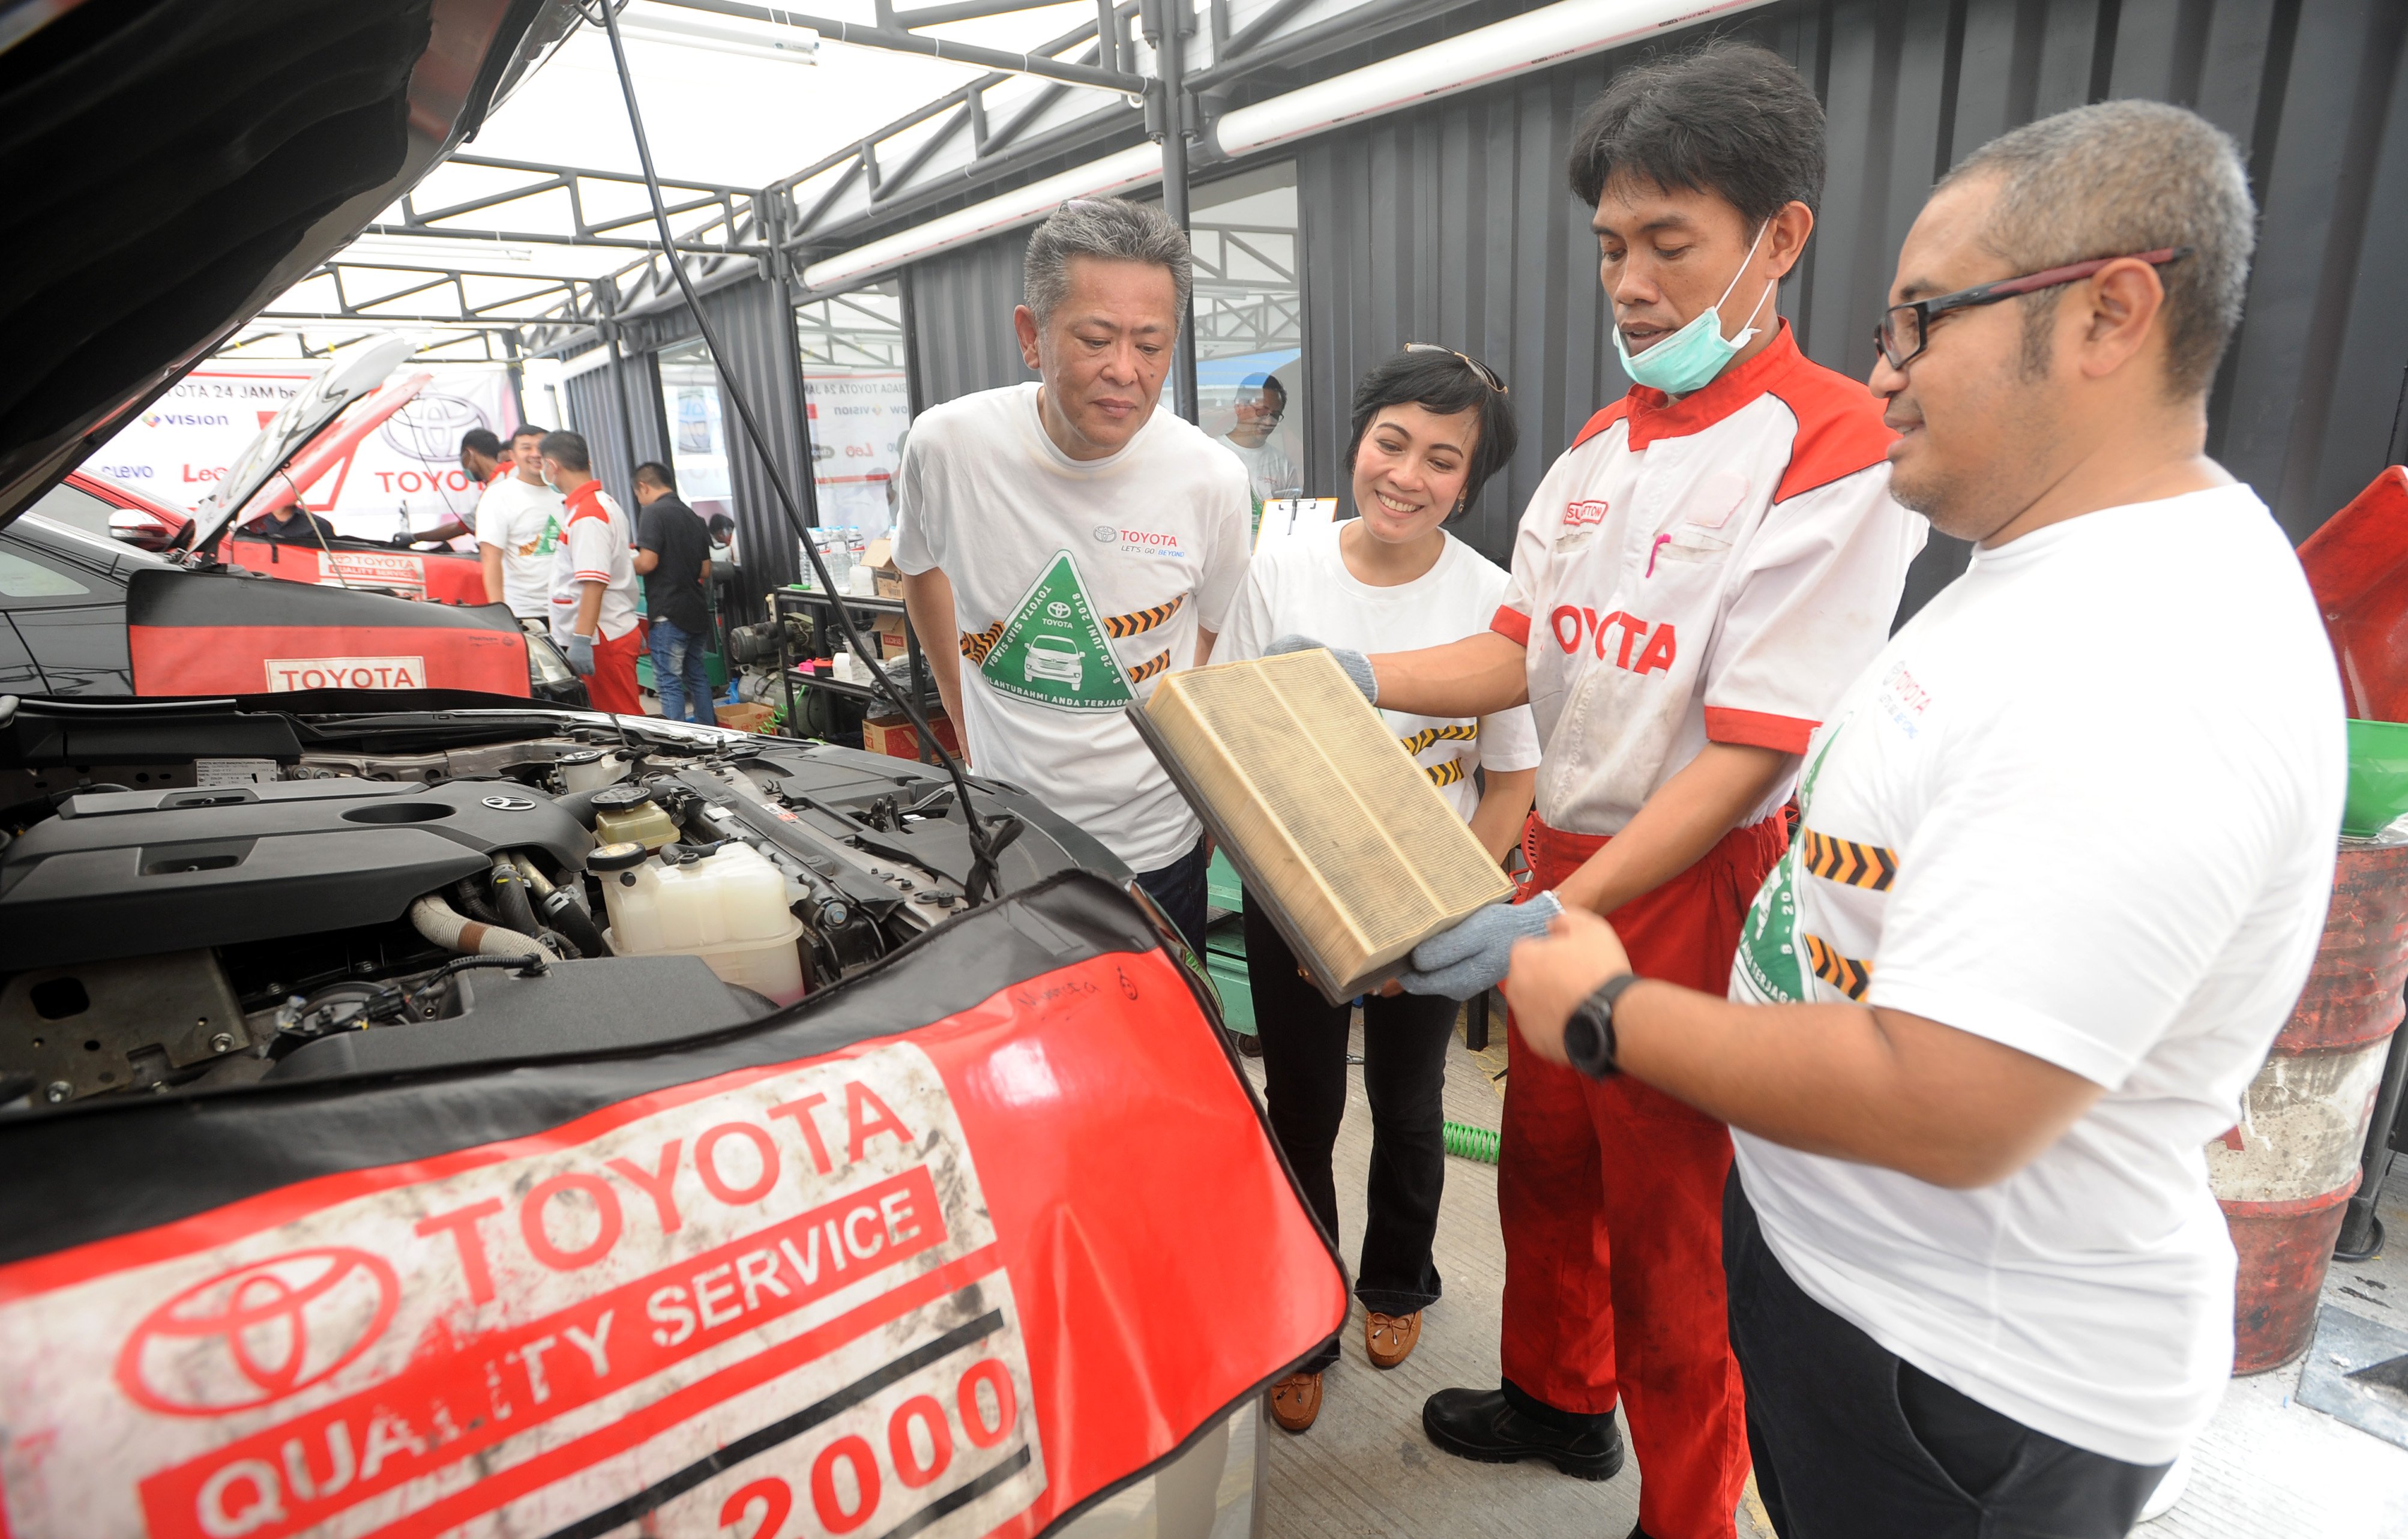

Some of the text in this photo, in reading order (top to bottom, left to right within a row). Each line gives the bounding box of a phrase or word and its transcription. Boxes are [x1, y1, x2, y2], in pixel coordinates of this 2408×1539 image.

[215, 385, 233, 399] 24
[240, 386, 274, 399] JAM
[375, 471, 486, 493] TOYO
[1121, 529, 1178, 547] TOYOTA
[355, 555, 415, 569] TOYOTA
[1121, 545, 1142, 553] LET'S
[1158, 549, 1185, 558] BEYOND
[332, 565, 414, 579] QUALITY SERVICE
[1072, 592, 1091, 621] 2018
[987, 585, 1052, 667] TOYOTA SIAP SIAGA
[1041, 618, 1074, 629] TOYOTA
[1086, 625, 1105, 649] JUNI
[1100, 655, 1113, 667] 20
[279, 667, 415, 691] TOYOTA
[1052, 696, 1080, 707] ANDA
[1894, 670, 1932, 716] TOYOTA
[1781, 891, 1795, 916] 20
[413, 1079, 915, 1307] TOYOTA
[645, 1188, 922, 1347] SERVICE
